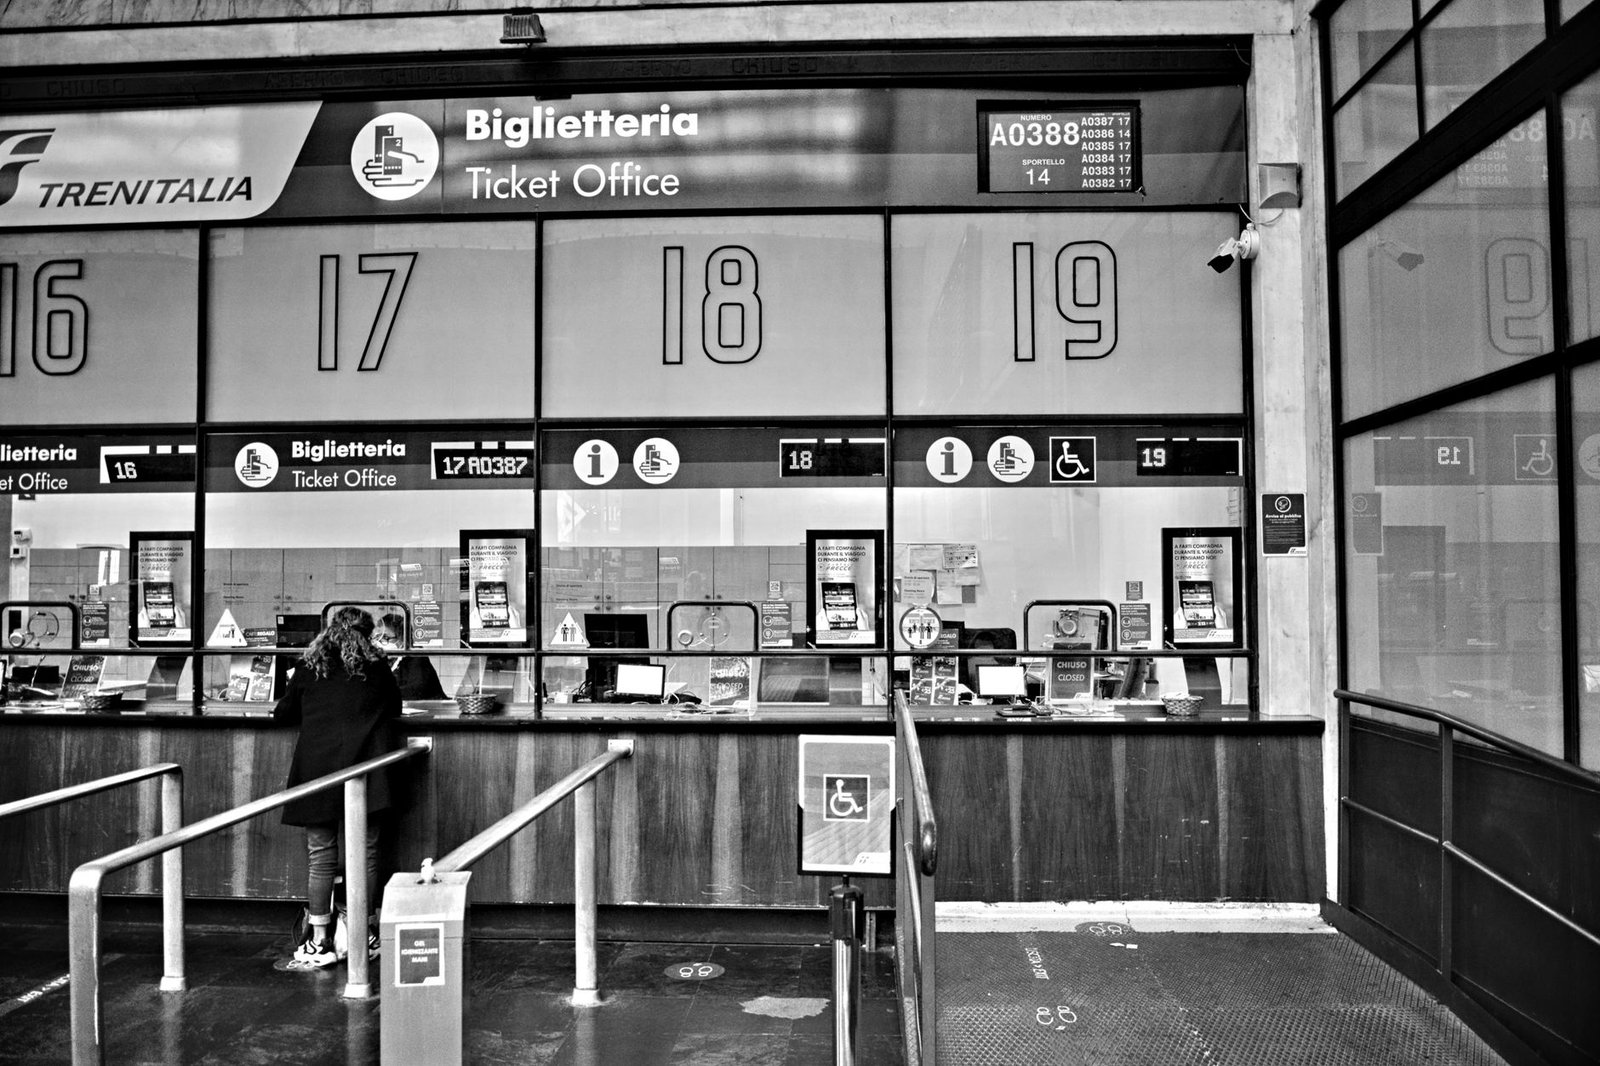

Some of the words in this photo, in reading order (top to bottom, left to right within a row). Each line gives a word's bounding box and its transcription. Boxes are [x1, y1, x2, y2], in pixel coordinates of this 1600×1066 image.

[466, 103, 698, 148] Biglietteria
[1081, 117, 1115, 126] A0387
[1119, 116, 1131, 126] 17
[990, 121, 1080, 146] A0388
[1081, 130, 1115, 138] A0386
[1119, 129, 1131, 138] 14
[1081, 142, 1115, 151] A0385
[1119, 142, 1131, 151] 17
[1022, 158, 1066, 166] SPORTELLO
[1081, 154, 1115, 163] A0384
[1119, 154, 1131, 163] 17
[1026, 168, 1051, 185] 14
[1081, 166, 1115, 175] A0383
[1119, 166, 1131, 175] 17
[466, 164, 561, 200] Ticket
[573, 161, 680, 198] Office
[1081, 179, 1115, 188] A0382
[1119, 178, 1131, 188] 17
[38, 176, 252, 208] TRENITALIA
[662, 244, 763, 365] 18
[1013, 240, 1118, 362] 19
[0, 259, 89, 377] 16
[317, 252, 419, 372] 17
[291, 439, 406, 462] Biglietteria
[789, 450, 812, 470] 18
[1141, 448, 1166, 467] 19
[114, 461, 138, 479] 16
[443, 457, 464, 475] 17
[468, 456, 528, 475] A0387
[18, 472, 68, 490] Office
[292, 470, 339, 488] Ticket
[344, 468, 397, 488] Office
[1056, 661, 1087, 669] CHIUSO
[1057, 673, 1085, 682] CLOSED
